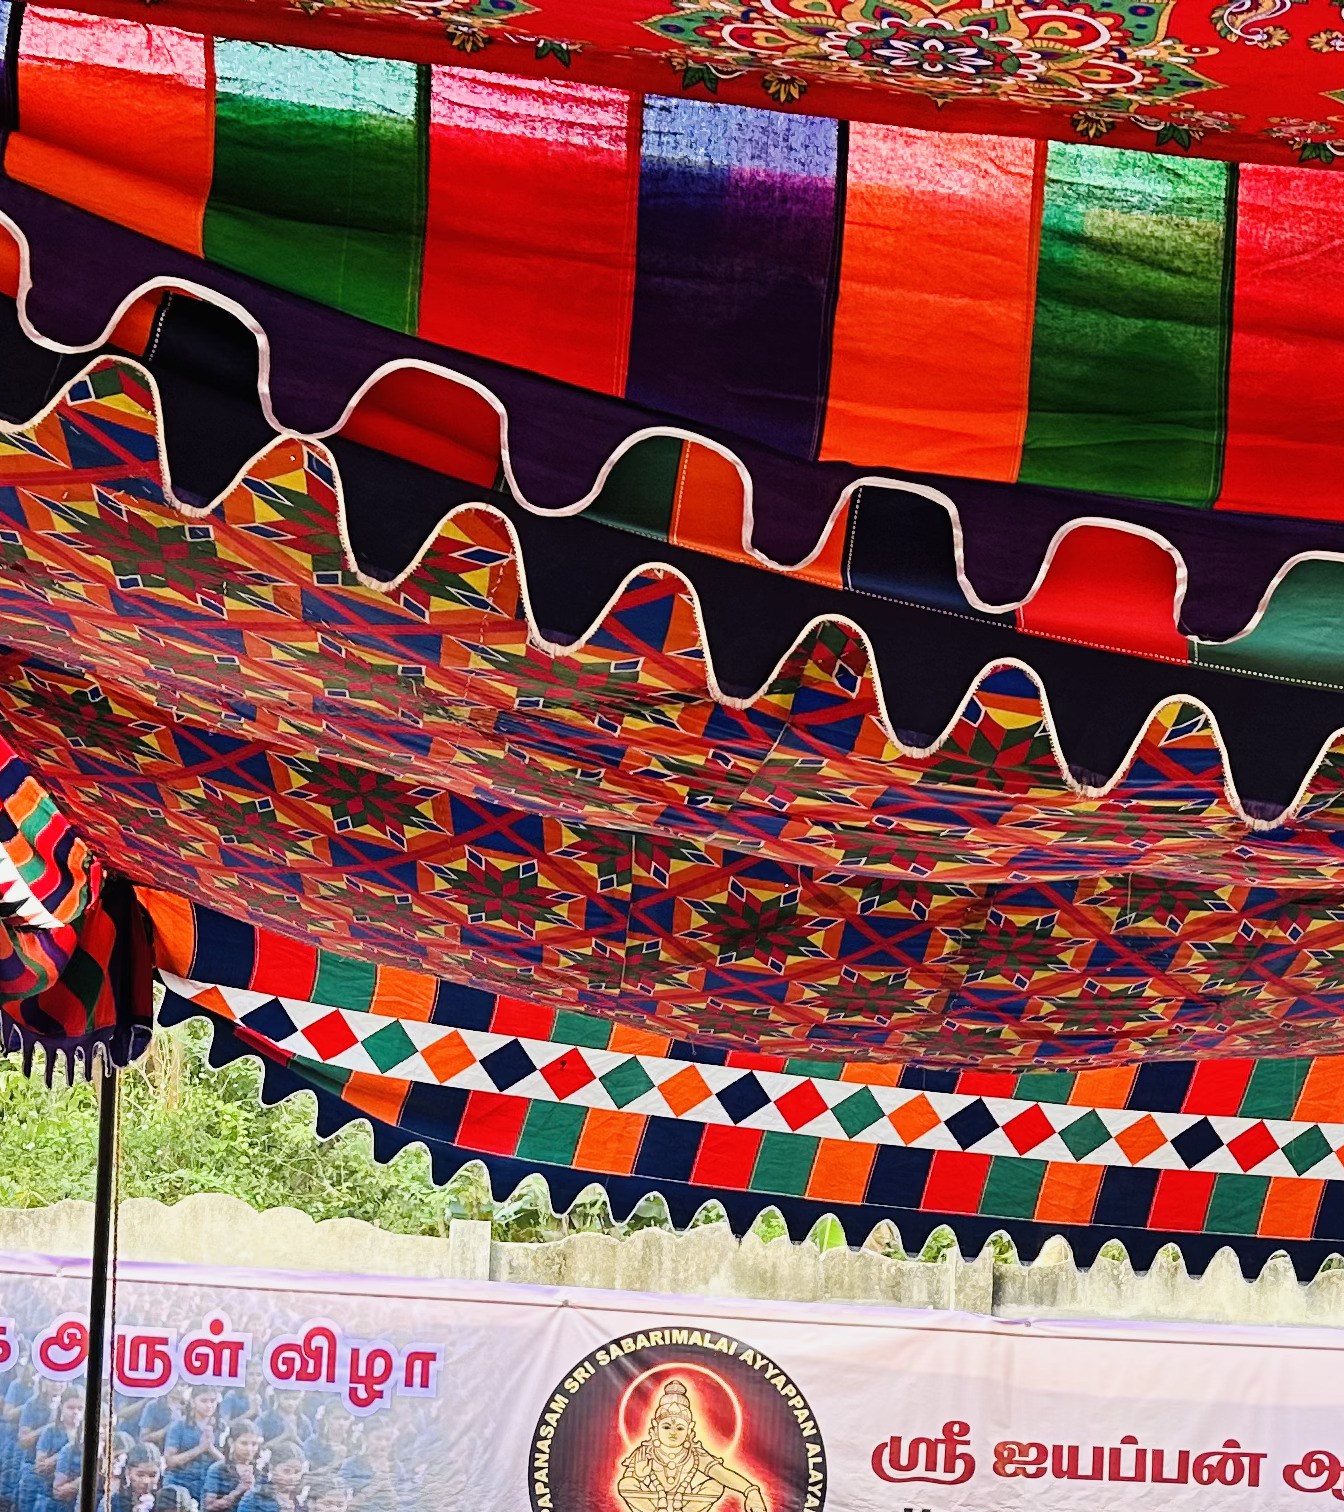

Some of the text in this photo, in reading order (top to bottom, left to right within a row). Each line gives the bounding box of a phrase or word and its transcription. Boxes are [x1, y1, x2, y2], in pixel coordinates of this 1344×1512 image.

[39, 1319, 244, 1388] அருள்
[270, 1326, 437, 1406] விழா
[563, 1361, 596, 1394] SRI
[596, 1329, 738, 1366] SABARIMALAI
[739, 1348, 817, 1437] AYYAPPAN
[993, 1435, 1268, 1488] ஐயப்பன்
